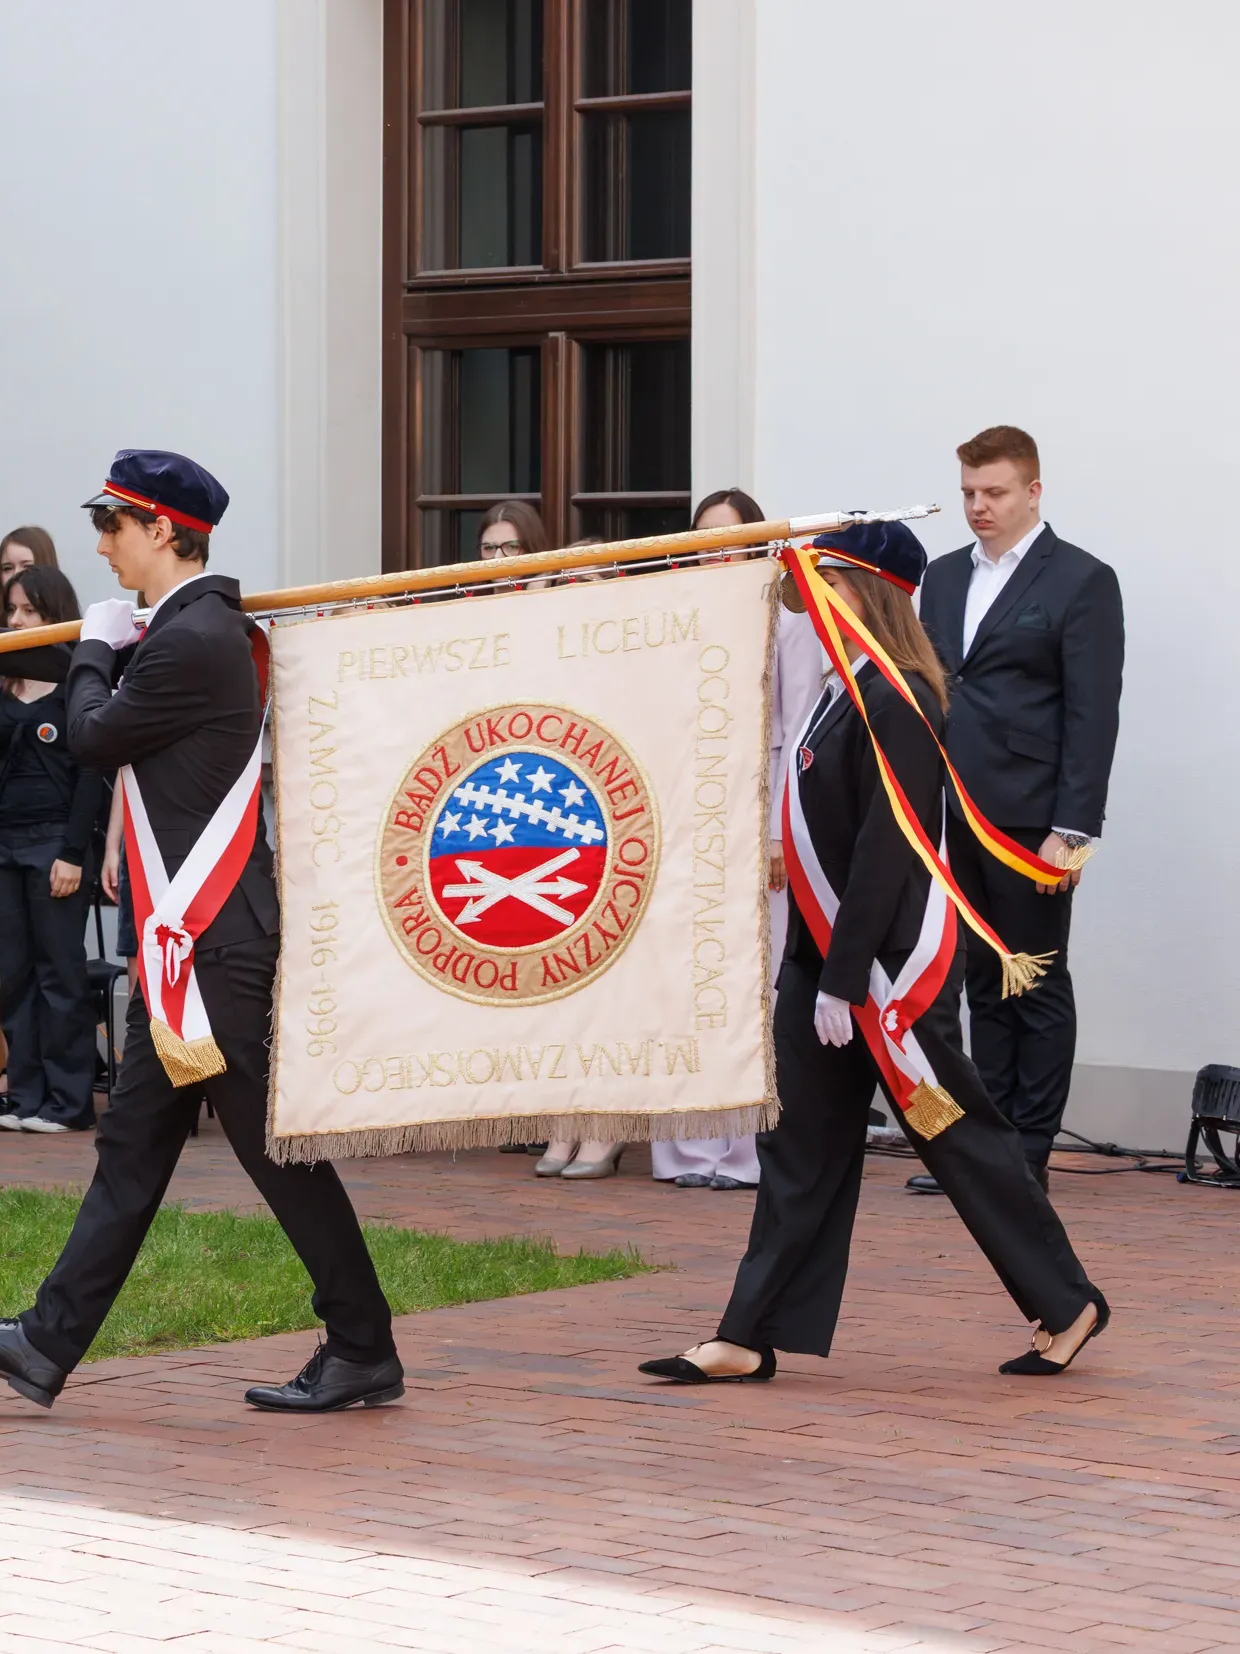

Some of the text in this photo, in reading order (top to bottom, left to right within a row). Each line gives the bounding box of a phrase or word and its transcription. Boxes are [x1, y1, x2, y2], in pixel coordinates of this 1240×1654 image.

[337, 606, 700, 683] PIERWSZE LICEUM
[466, 710, 645, 821] UKOCHANEJ
[306, 690, 347, 1058] ZAMOŚĆ 1916-1996
[540, 837, 649, 990] OJCZYZNY
[393, 885, 519, 992] PODPORĄ
[332, 1043, 568, 1095] ZAMOYSKIEGO
